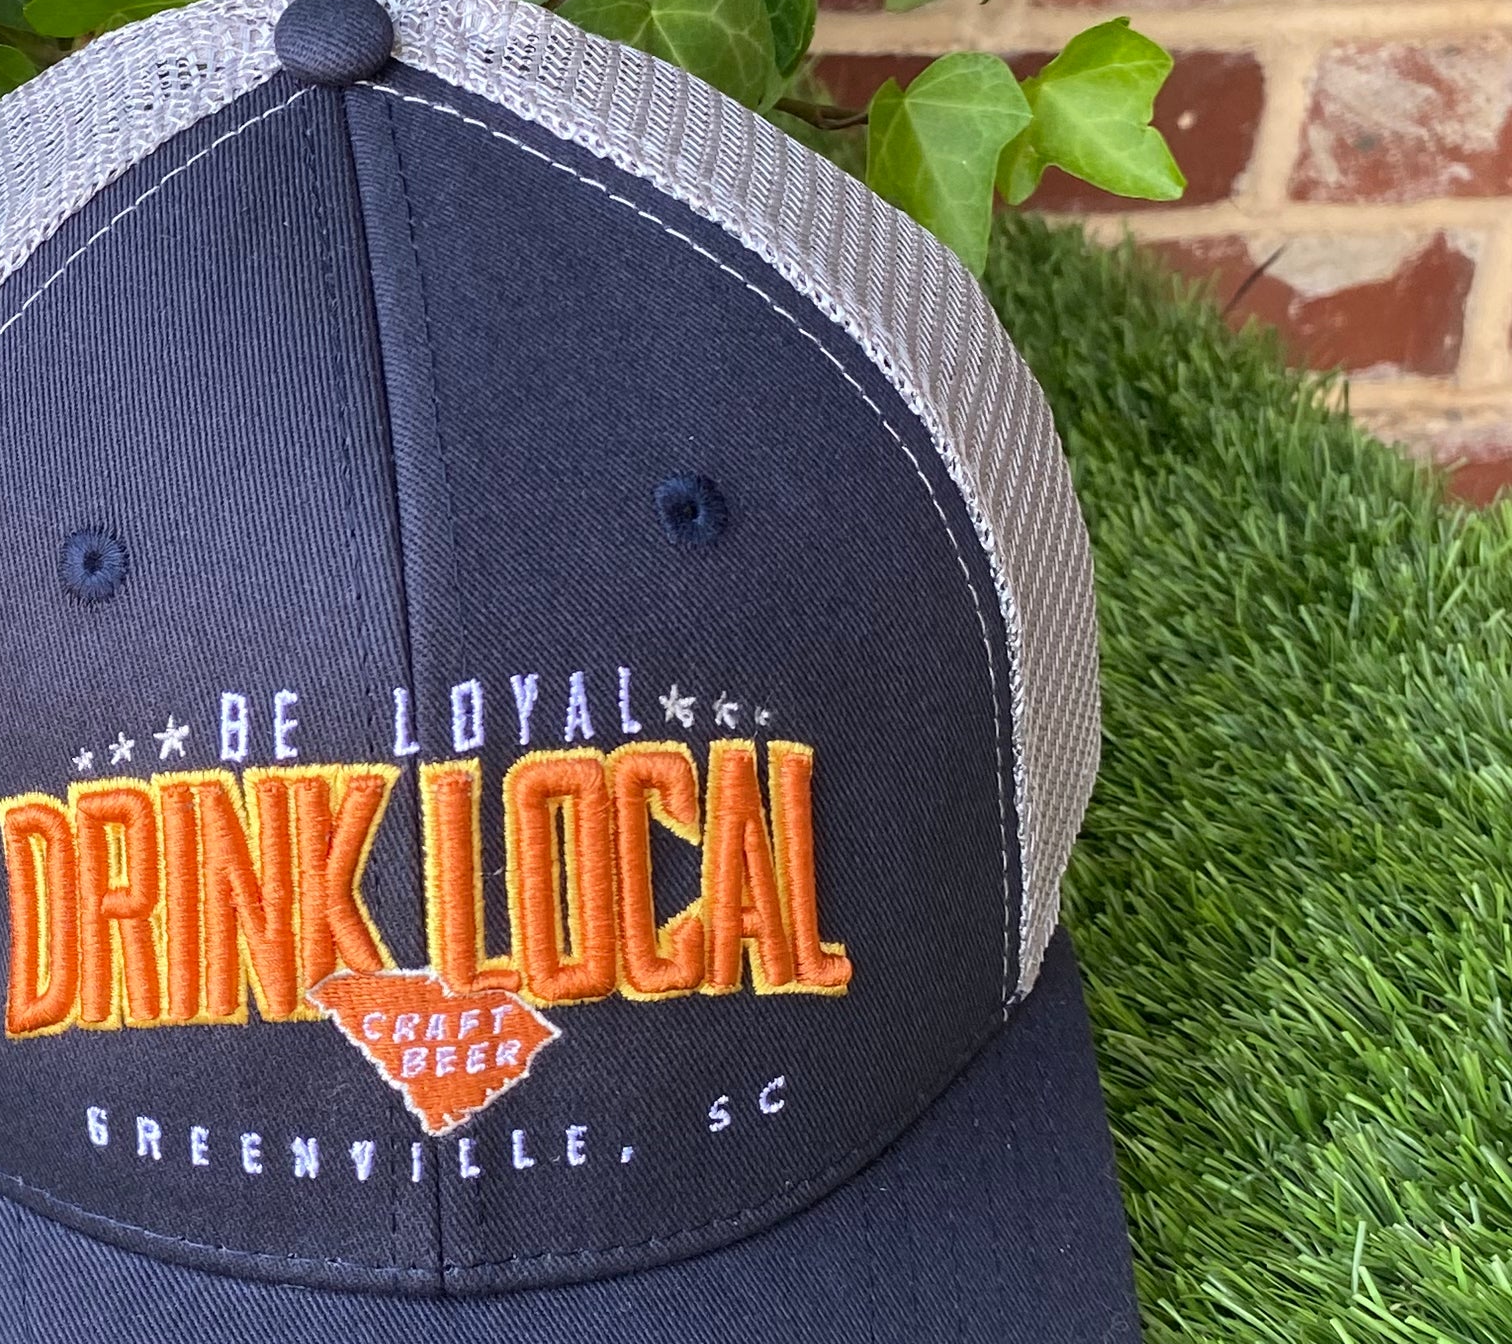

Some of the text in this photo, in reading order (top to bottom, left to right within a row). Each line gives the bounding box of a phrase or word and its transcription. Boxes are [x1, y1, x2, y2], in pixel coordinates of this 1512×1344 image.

[219, 666, 642, 763] BE LOYAL
[419, 738, 854, 1008] LOCAL
[361, 1004, 514, 1044] CRAFT
[400, 1039, 522, 1079] BEER
[87, 1075, 786, 1184] GREENVILLE, SC
